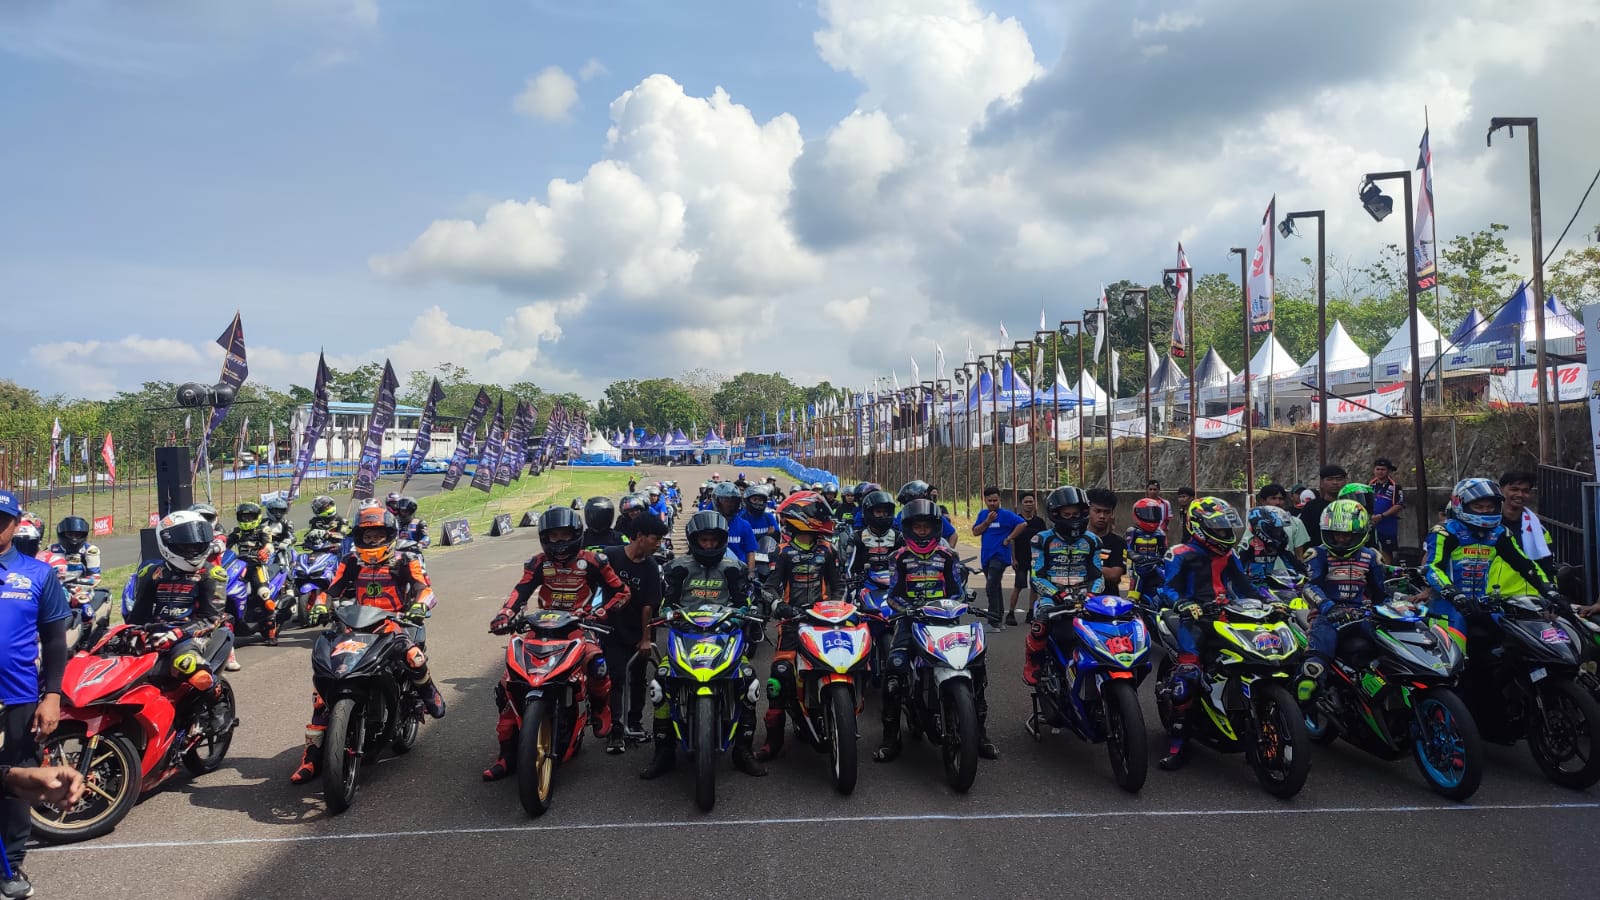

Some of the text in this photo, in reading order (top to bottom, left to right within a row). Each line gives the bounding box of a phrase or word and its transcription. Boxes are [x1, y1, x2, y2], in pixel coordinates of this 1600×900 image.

[1337, 398, 1368, 413] KYB
[1204, 419, 1222, 430] KYB
[94, 518, 109, 530] NGK
[825, 638, 852, 649] 102
